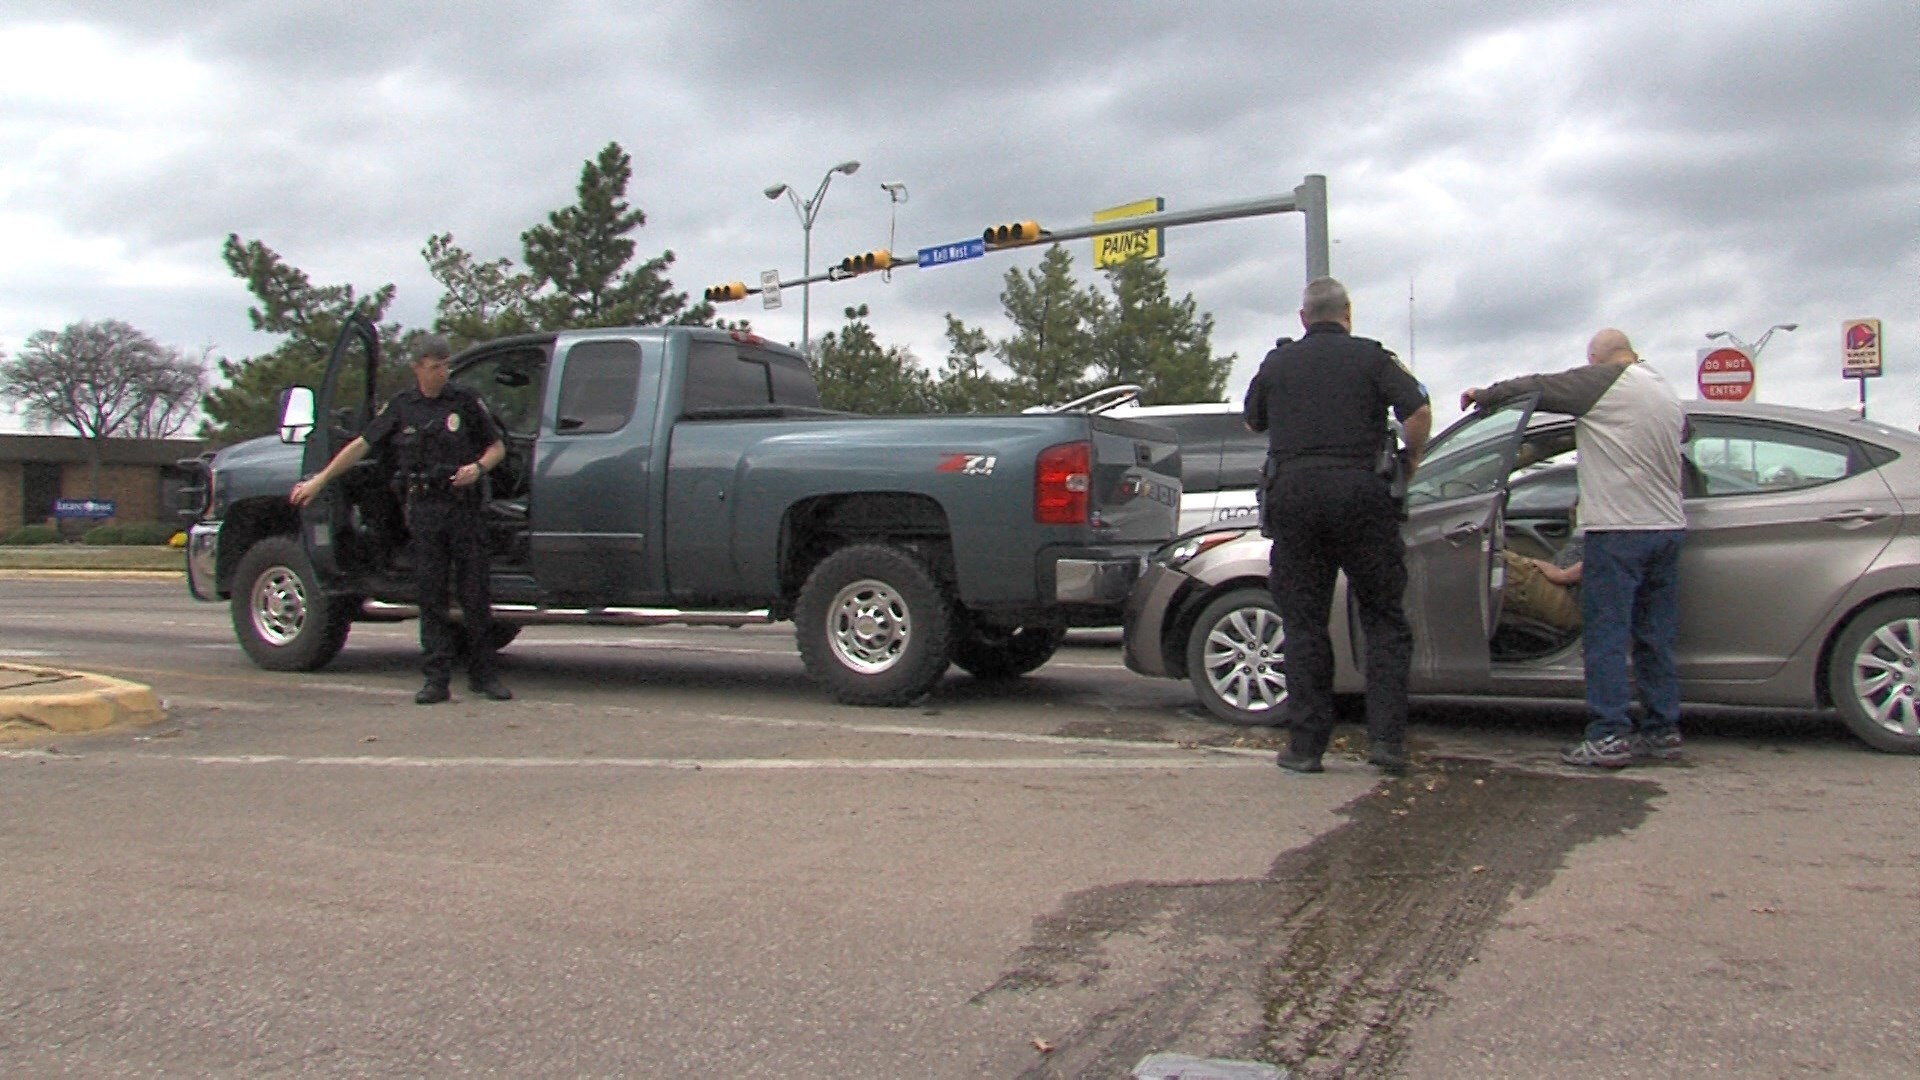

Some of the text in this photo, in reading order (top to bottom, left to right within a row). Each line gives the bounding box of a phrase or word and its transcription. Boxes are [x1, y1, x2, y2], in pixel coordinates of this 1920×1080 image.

[1102, 229, 1149, 255] PAINTS
[949, 245, 967, 258] West
[1704, 358, 1746, 370] DO NOT
[1709, 385, 1742, 396] ENTER
